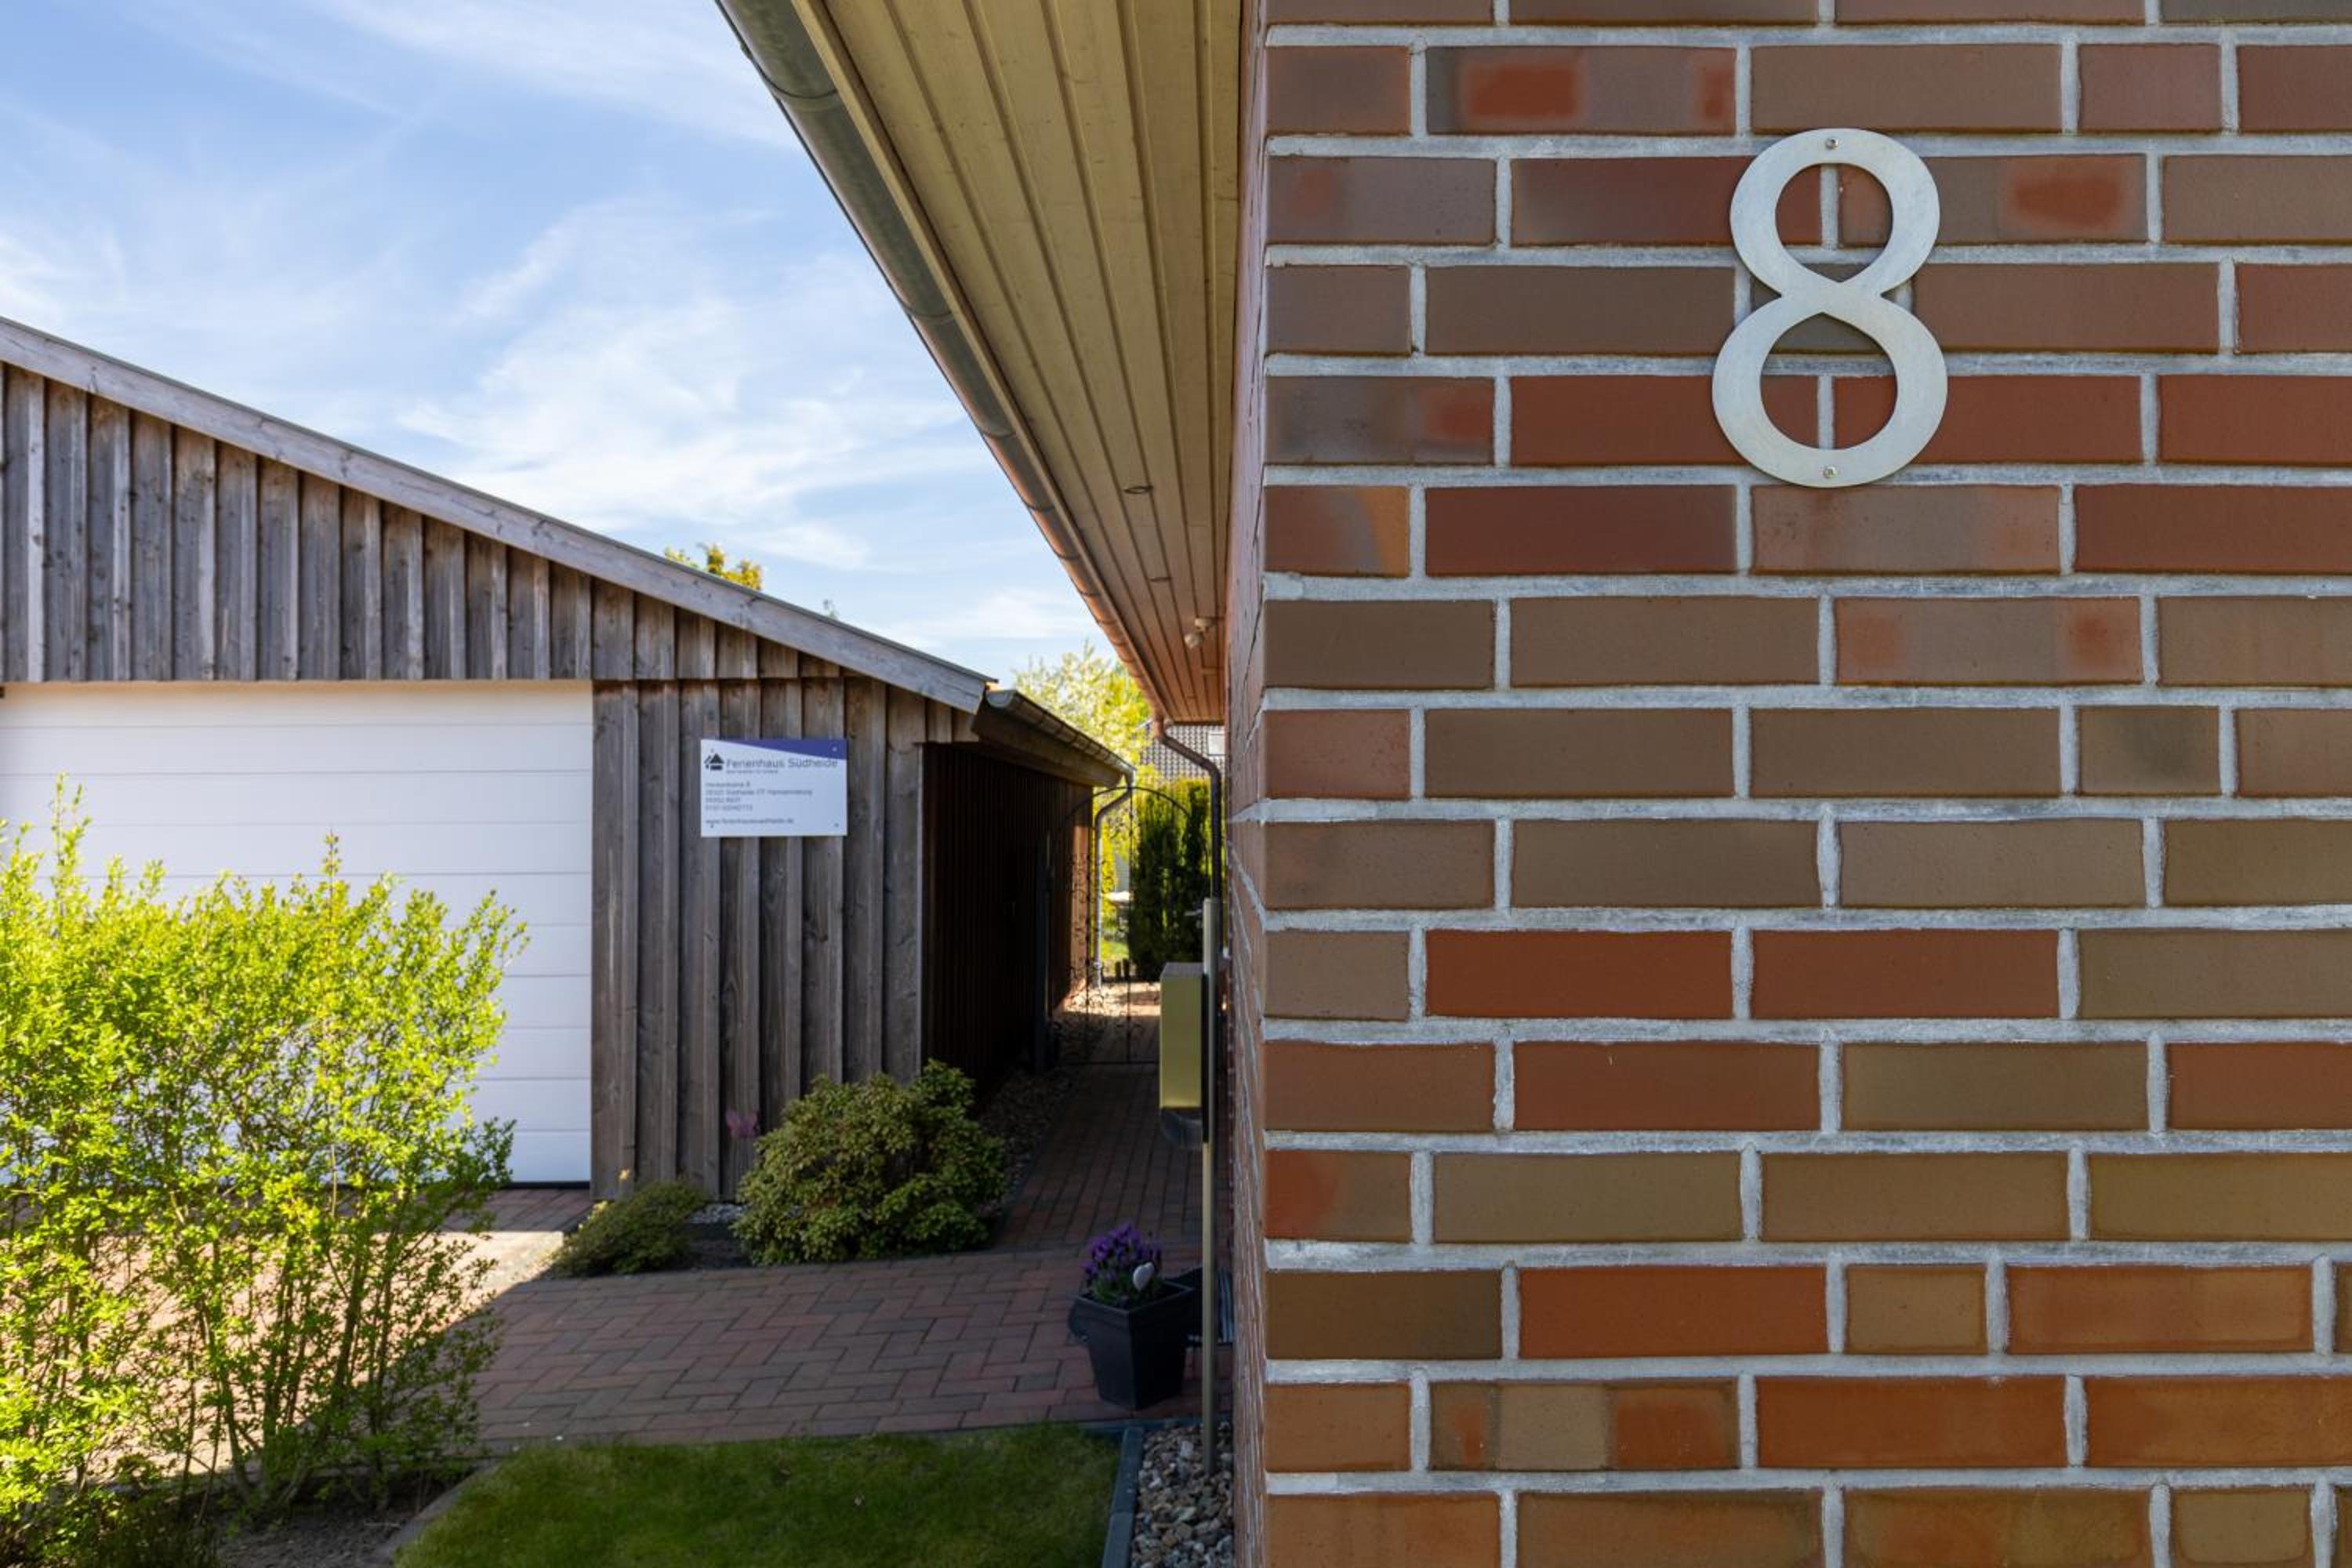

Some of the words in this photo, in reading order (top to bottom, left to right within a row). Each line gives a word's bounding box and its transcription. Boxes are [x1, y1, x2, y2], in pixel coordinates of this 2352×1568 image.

[1711, 128, 1947, 488] 8
[727, 759, 785, 768] Ferienhaus
[788, 758, 838, 768] Südheide
